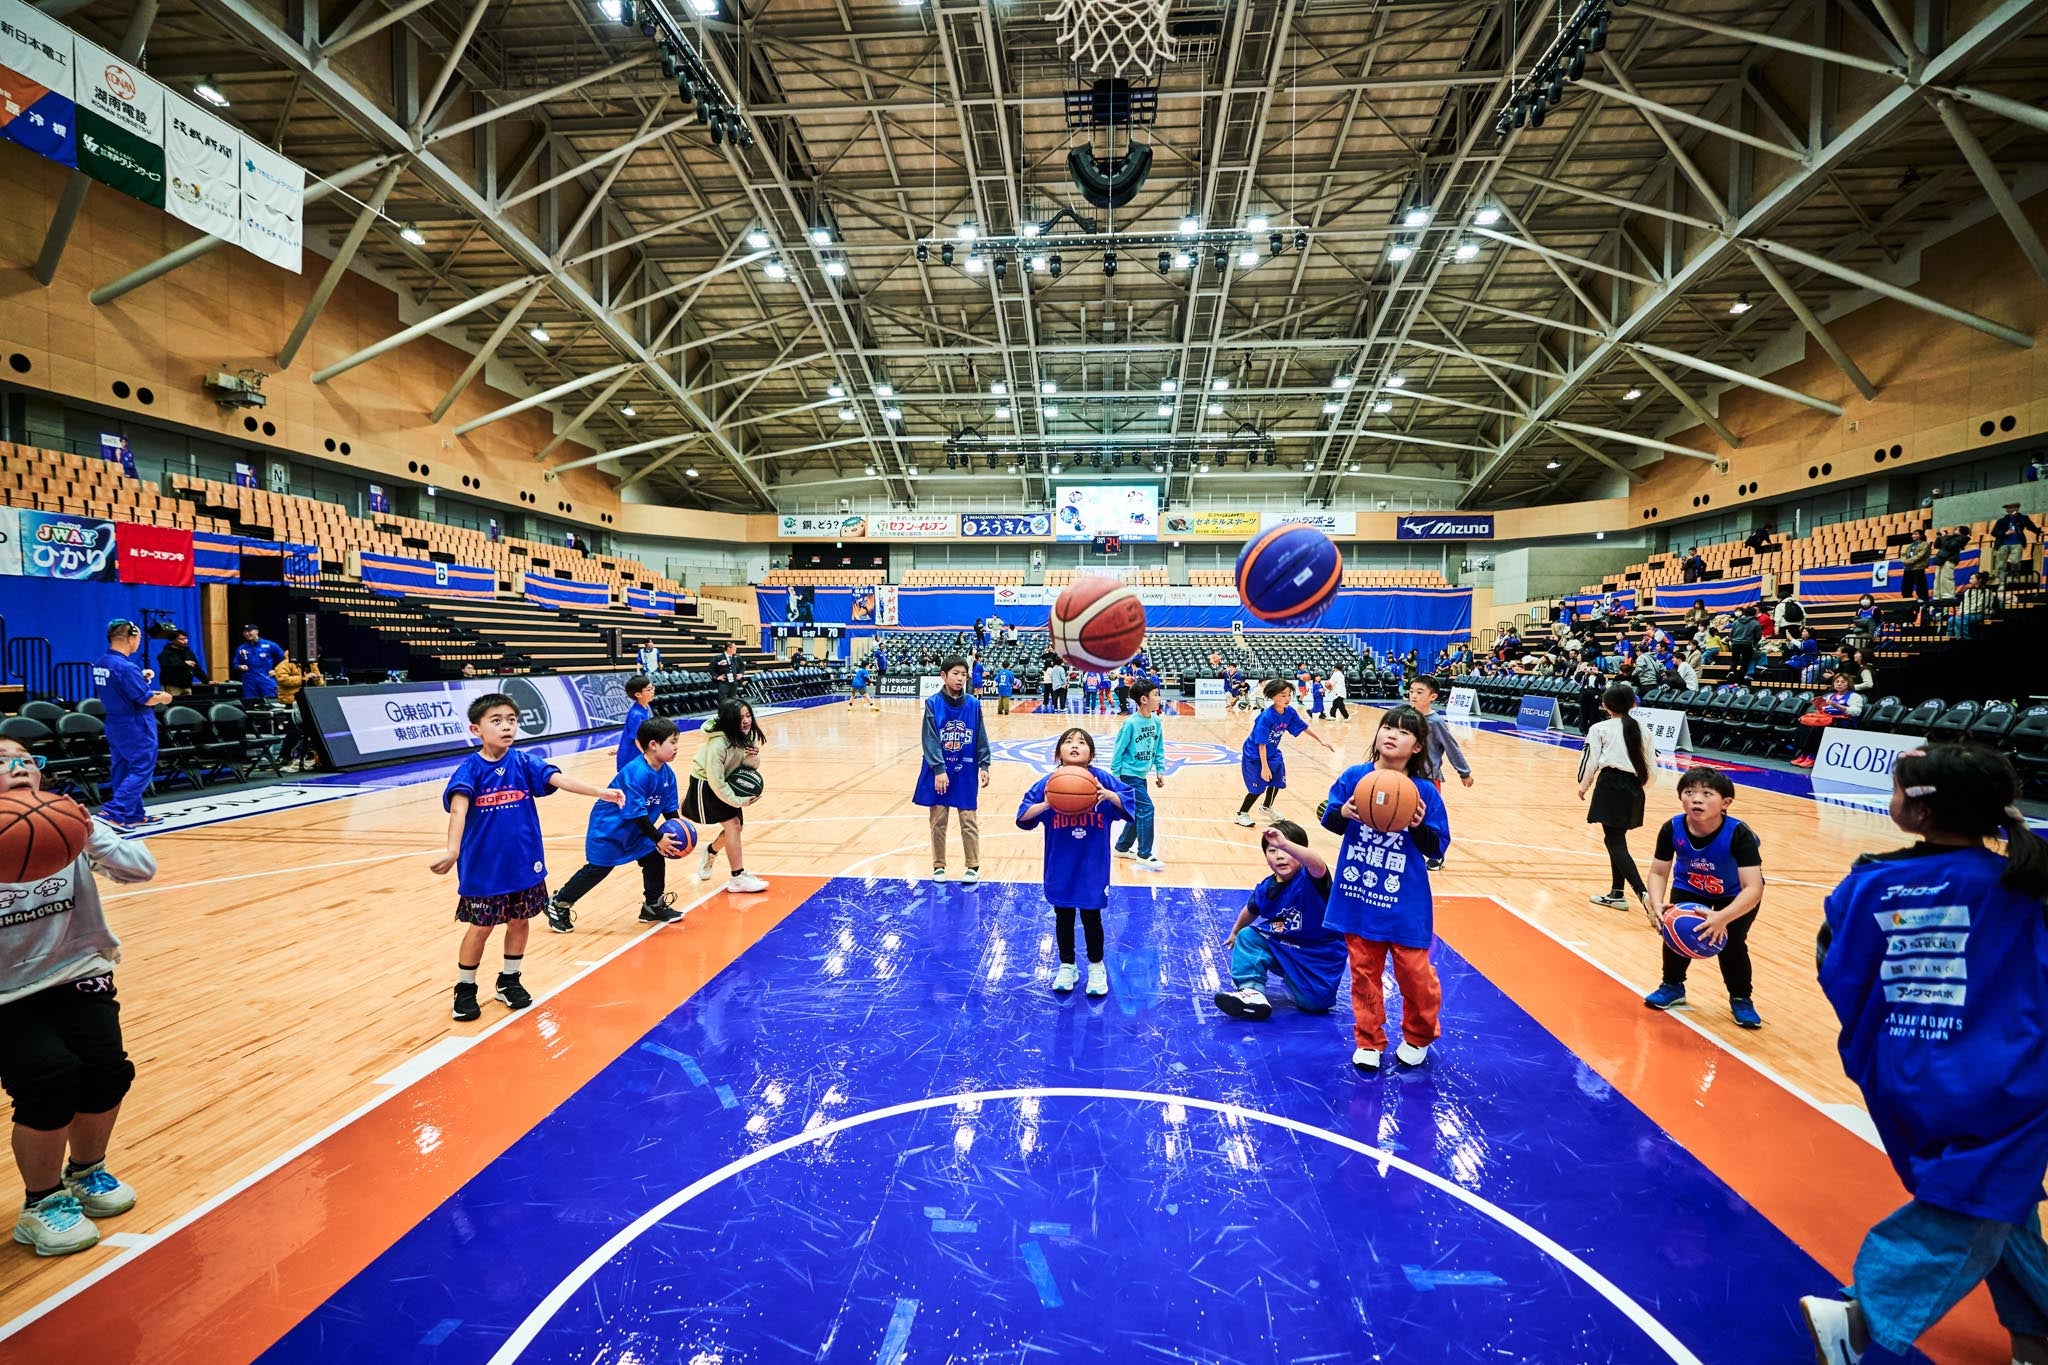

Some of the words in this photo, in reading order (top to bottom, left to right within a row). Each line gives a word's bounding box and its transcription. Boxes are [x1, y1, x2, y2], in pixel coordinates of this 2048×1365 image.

[1, 20, 68, 67] 新日本電工
[95, 86, 148, 126] 湖南電設
[274, 470, 283, 482] N
[979, 520, 1029, 534] ろうきん
[38, 527, 98, 547] JWAY
[1106, 537, 1119, 551] 24
[33, 545, 106, 572] ひかり
[1875, 565, 1886, 583] C
[777, 627, 788, 637] 81
[827, 628, 838, 638] 70
[1234, 623, 1241, 632] R
[880, 685, 916, 694] B.LEAGUE
[1359, 823, 1404, 850] キッズ
[1346, 841, 1407, 873] 応援団
[1367, 891, 1399, 903] ROBOTS
